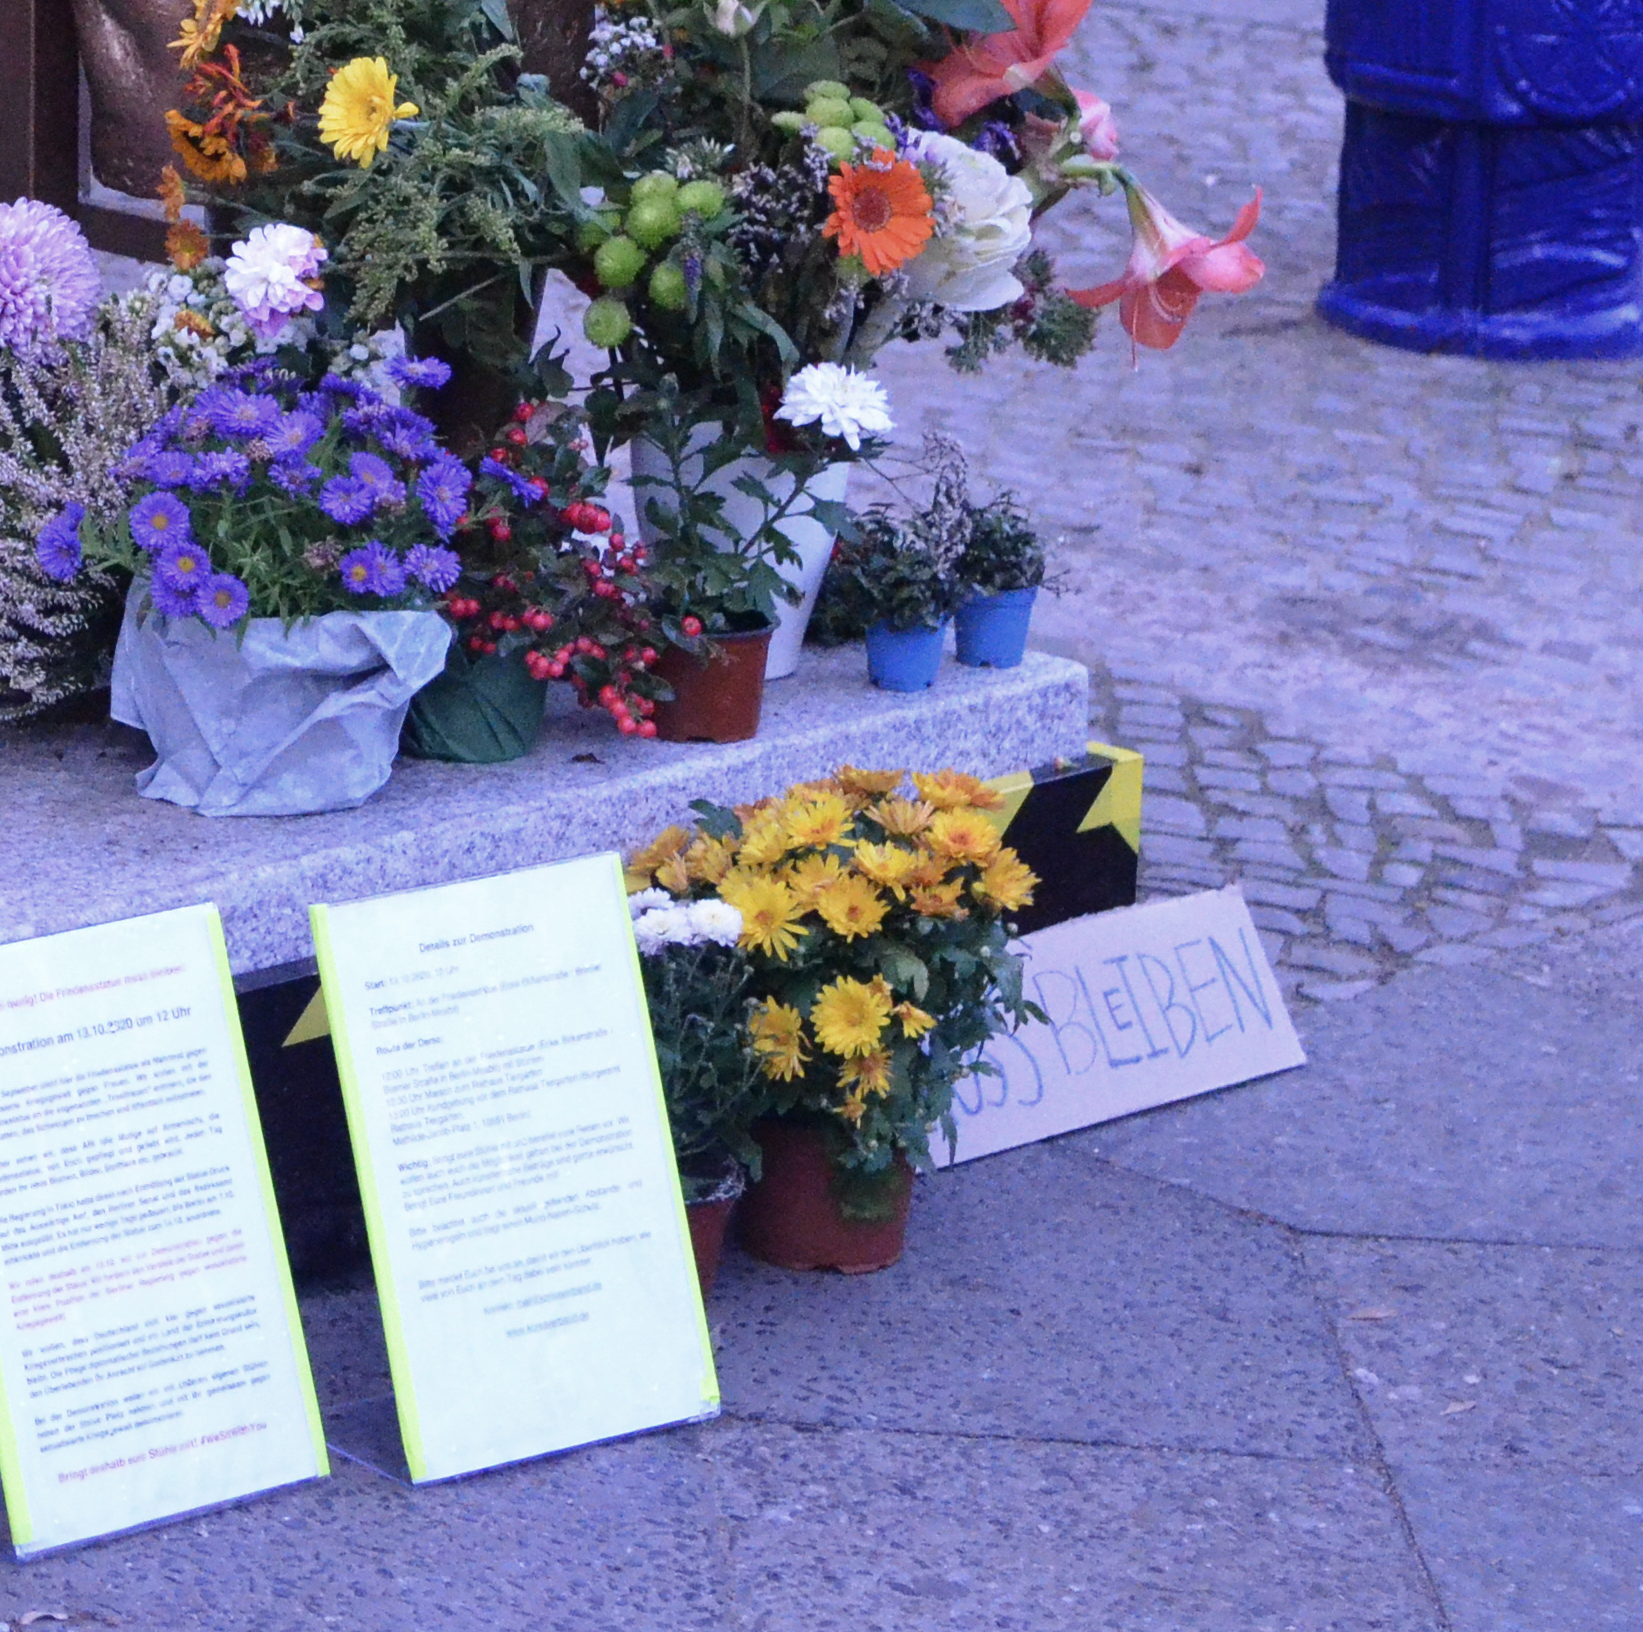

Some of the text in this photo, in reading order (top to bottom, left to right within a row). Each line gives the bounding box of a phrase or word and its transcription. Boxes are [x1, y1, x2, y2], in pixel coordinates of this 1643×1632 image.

[57, 1032, 73, 1043] am
[156, 1011, 168, 1022] 12
[171, 1006, 191, 1019] Uhr
[1032, 927, 1274, 1076] BLEIBEN
